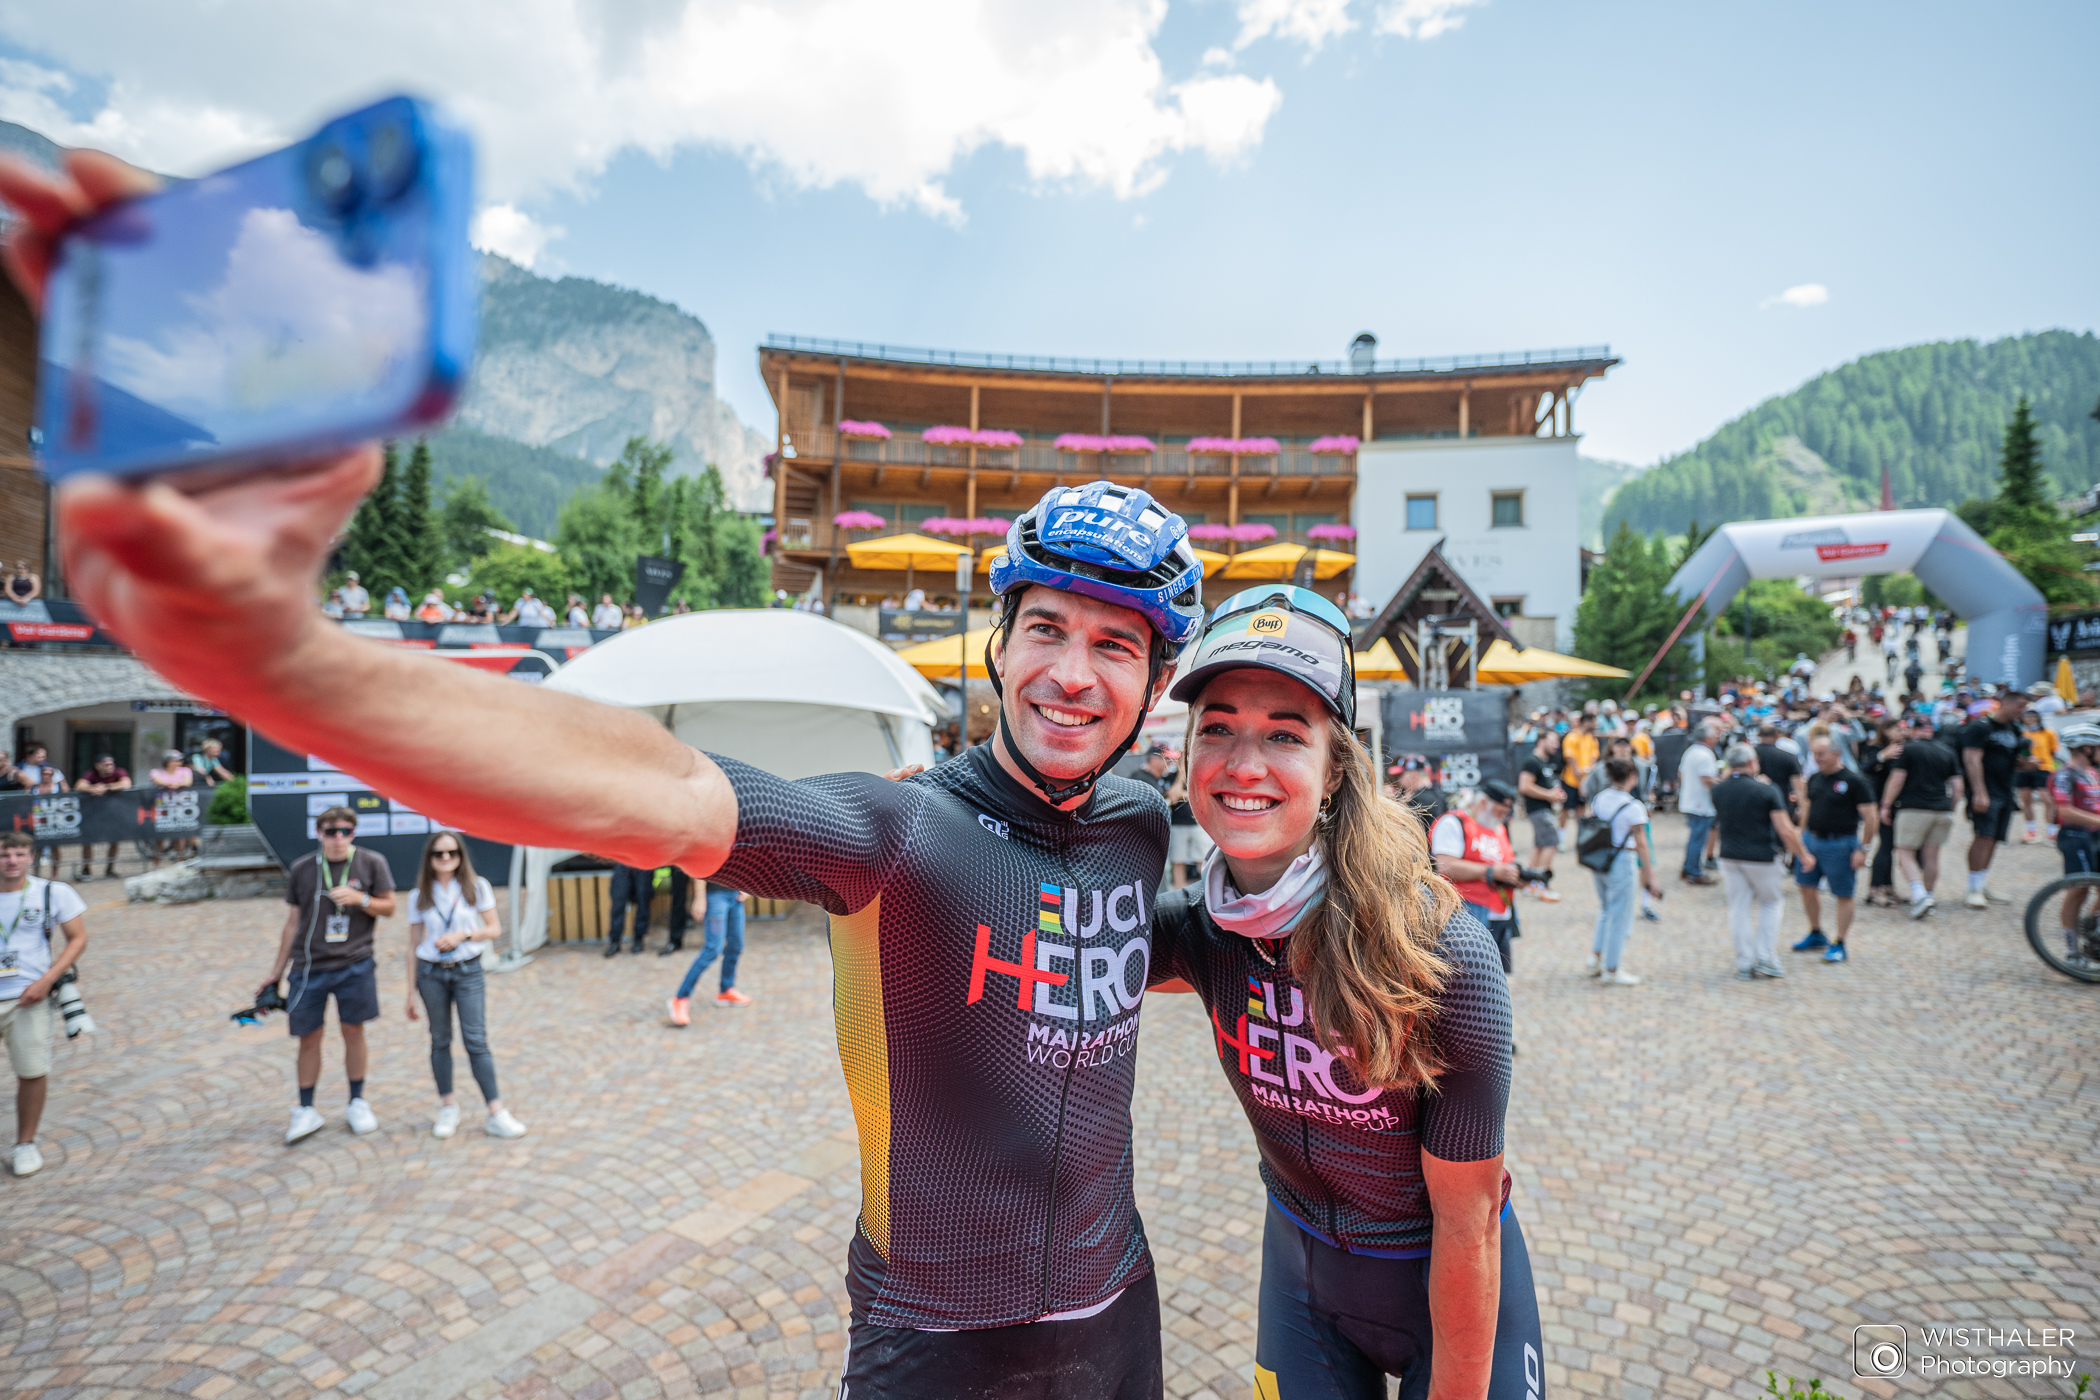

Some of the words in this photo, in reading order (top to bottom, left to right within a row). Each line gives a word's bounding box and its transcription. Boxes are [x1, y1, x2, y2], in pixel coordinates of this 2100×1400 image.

[1048, 528, 1144, 562] encapsulations
[1052, 511, 1151, 548] pure
[1157, 577, 1187, 603] SINGER
[1256, 618, 1280, 629] Buff
[1208, 640, 1320, 666] megamo
[1063, 879, 1147, 939] UCI
[967, 923, 1150, 1021] HERO
[1027, 1011, 1140, 1051] MARATHON
[1027, 1042, 1114, 1069] WORLD
[1251, 1083, 1390, 1121] MARATHON
[1351, 1116, 1400, 1131] CUP
